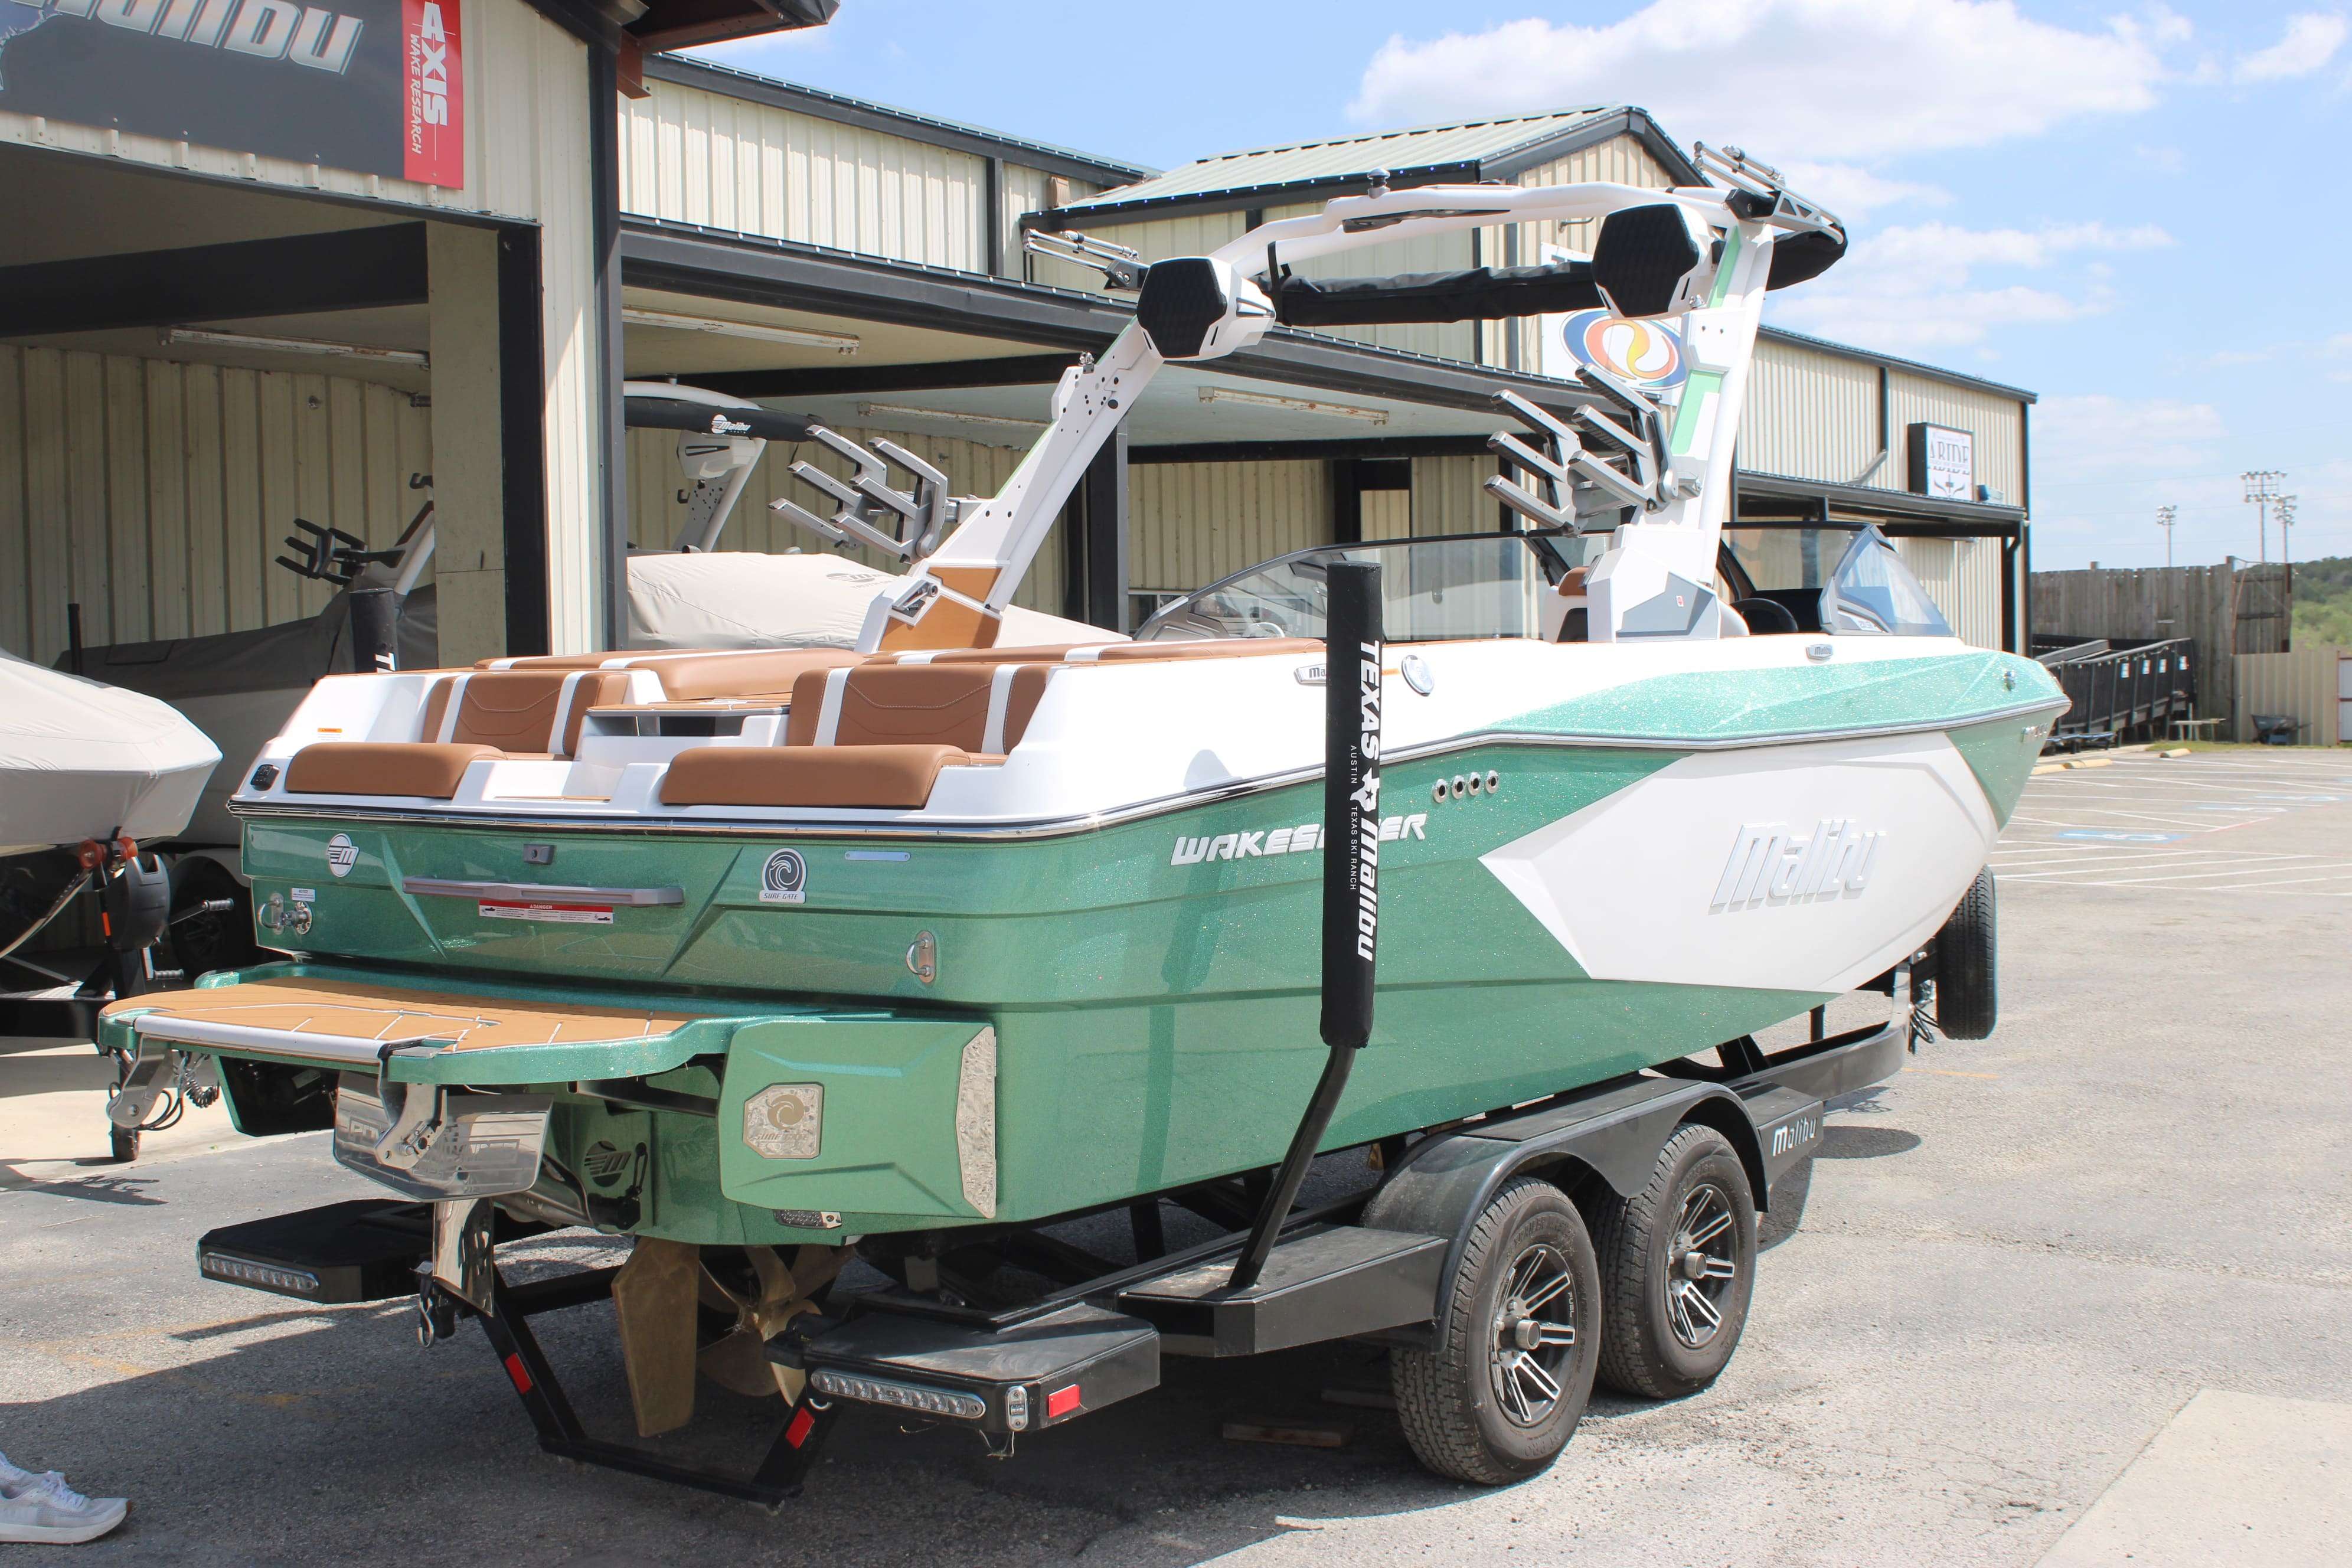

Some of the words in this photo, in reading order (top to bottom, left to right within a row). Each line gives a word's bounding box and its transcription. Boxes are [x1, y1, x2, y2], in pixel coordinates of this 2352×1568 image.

[409, 33, 421, 77] WAKE
[421, 1, 448, 126] AXIS
[410, 77, 422, 154] RESEARCH
[1360, 640, 1380, 760] TEXAS
[1357, 817, 1378, 962] Malibu
[1710, 817, 1888, 910] Malibu
[1772, 1115, 1818, 1157] Malibu
